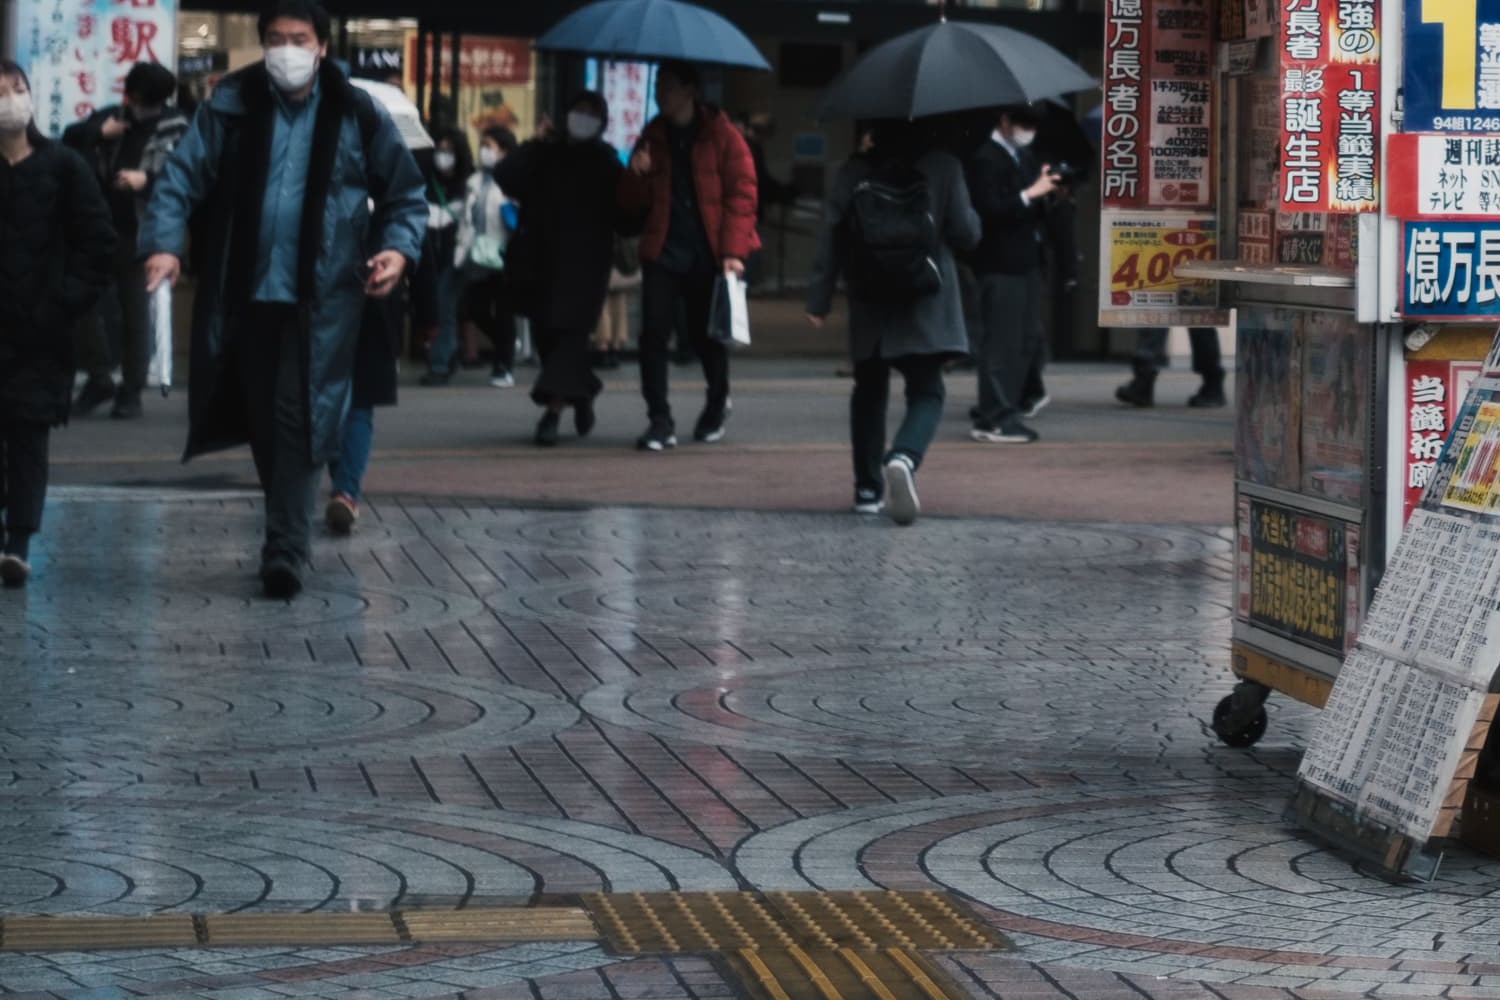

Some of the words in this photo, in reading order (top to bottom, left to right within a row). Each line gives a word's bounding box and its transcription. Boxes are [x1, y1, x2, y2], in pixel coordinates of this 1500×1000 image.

[1284, 69, 1324, 93] 最多
[1284, 98, 1323, 204] 誕生店
[1438, 168, 1468, 189] ネット
[1430, 191, 1465, 212] テレビ
